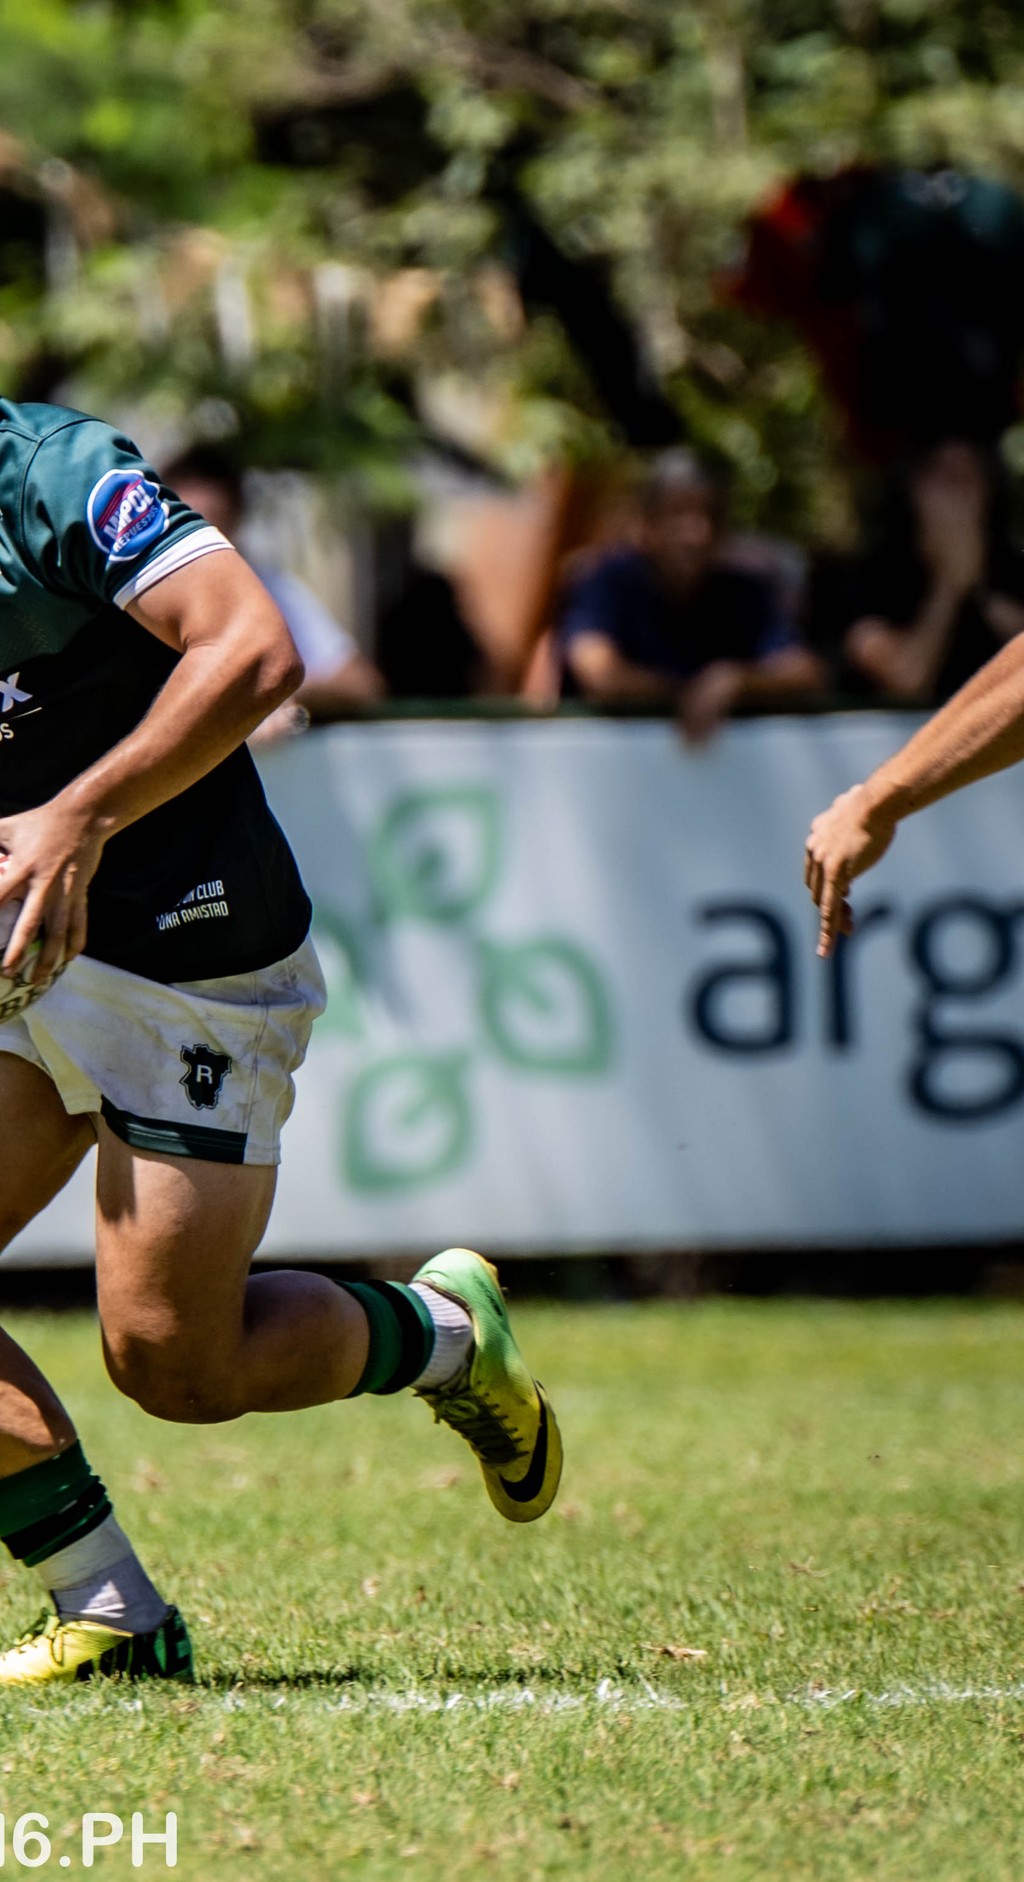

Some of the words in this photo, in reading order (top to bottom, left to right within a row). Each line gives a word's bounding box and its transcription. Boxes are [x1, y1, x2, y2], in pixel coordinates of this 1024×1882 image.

[196, 879, 225, 900] CLUB
[180, 900, 229, 923] AMISTAD
[692, 893, 1024, 1122] arg
[196, 1064, 214, 1085] R
